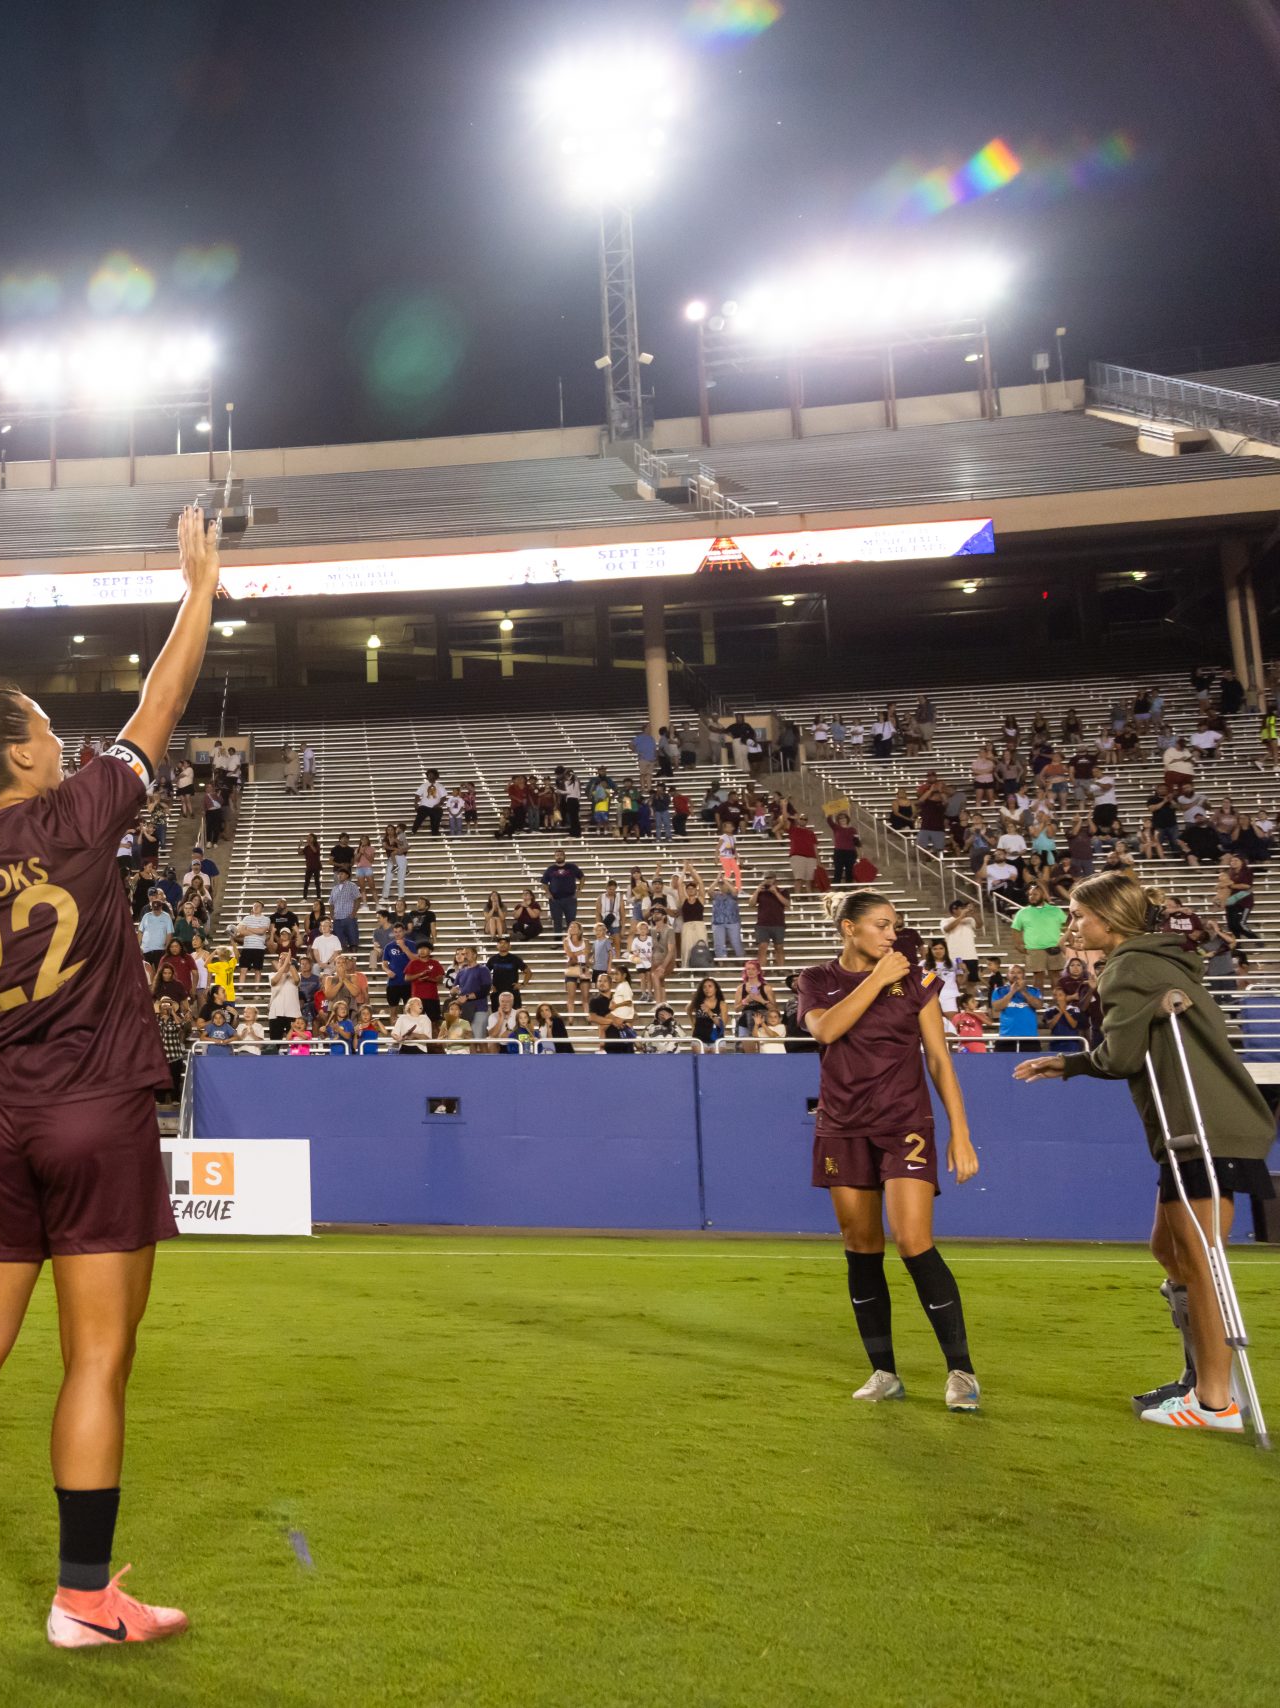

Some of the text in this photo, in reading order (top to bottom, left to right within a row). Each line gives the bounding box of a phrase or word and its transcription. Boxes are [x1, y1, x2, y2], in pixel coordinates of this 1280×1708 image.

[598, 546, 665, 560] SEPT 25
[92, 575, 153, 587] SEPT 25
[903, 1132, 928, 1164] 2
[204, 1161, 223, 1186] S
[171, 1199, 235, 1221] EAGUE
